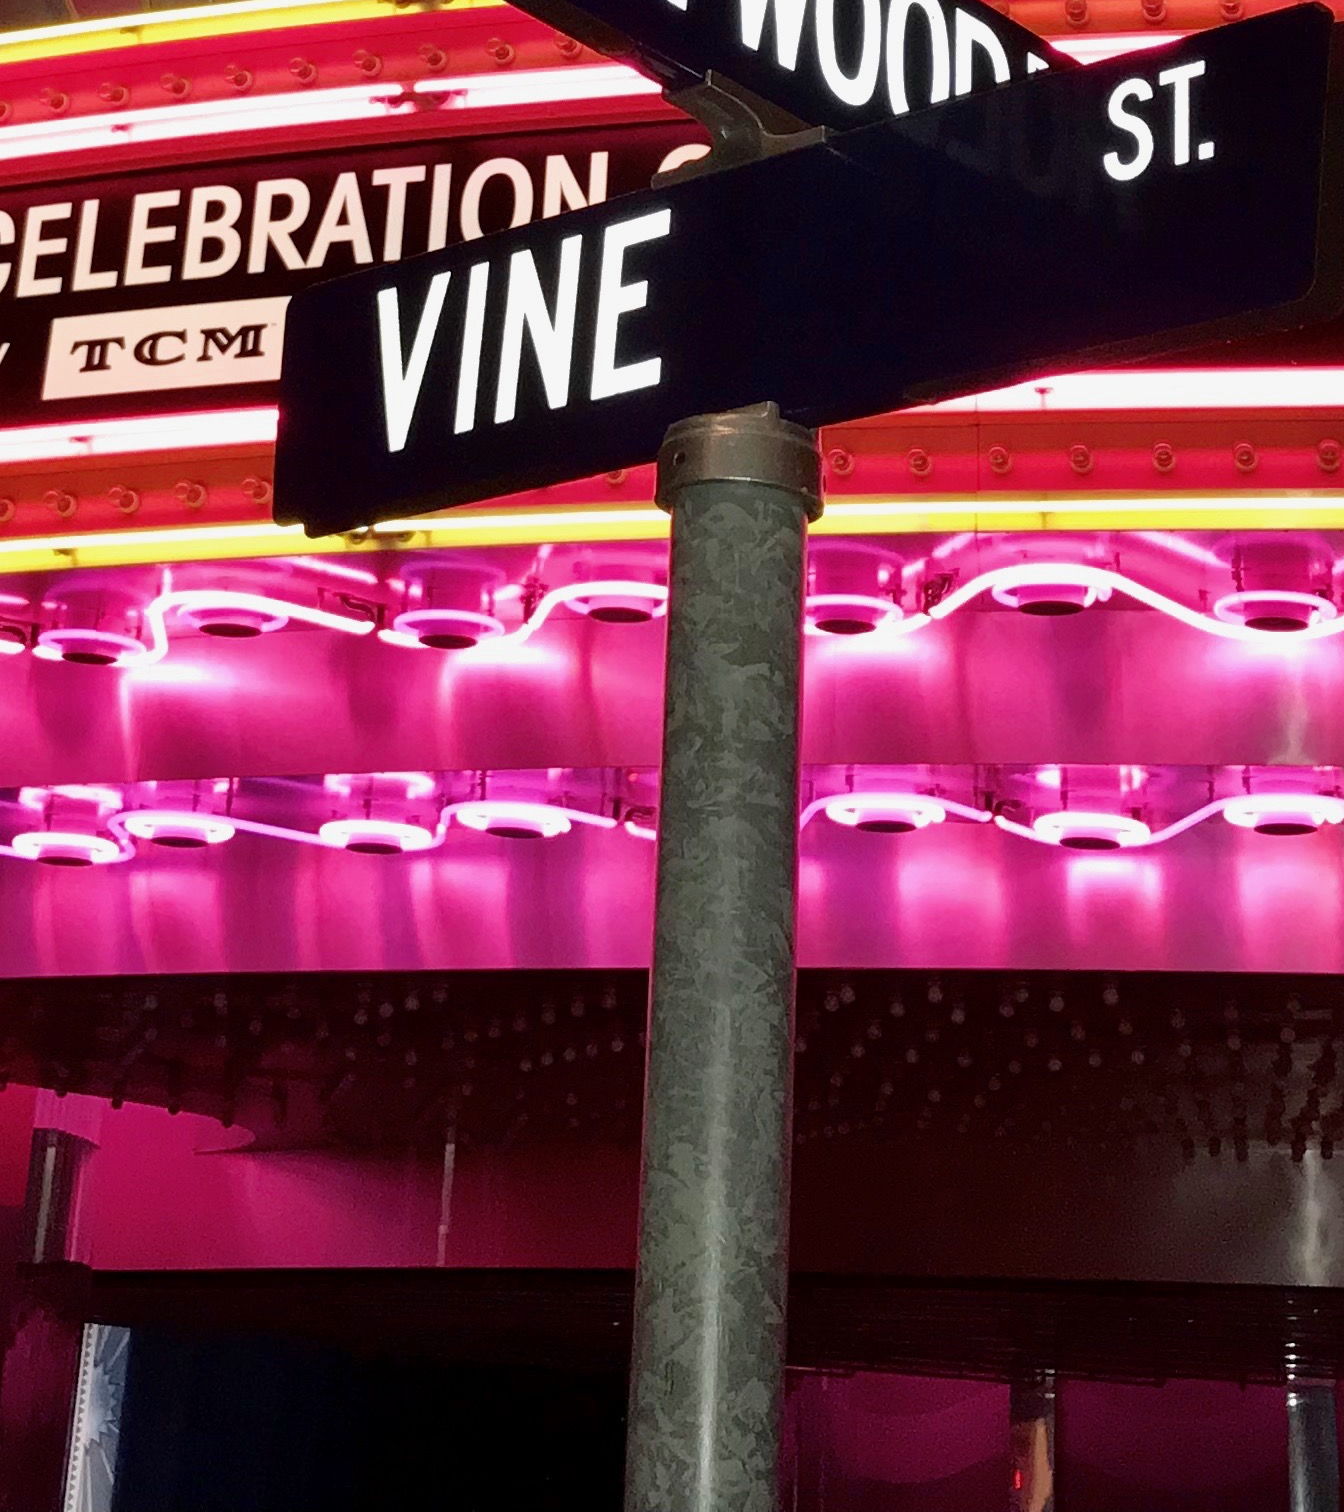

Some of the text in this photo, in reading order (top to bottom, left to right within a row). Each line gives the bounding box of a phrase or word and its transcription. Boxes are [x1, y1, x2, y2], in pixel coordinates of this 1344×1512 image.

[70, 323, 269, 373] TCM
[377, 59, 1215, 453] VINE ST.
